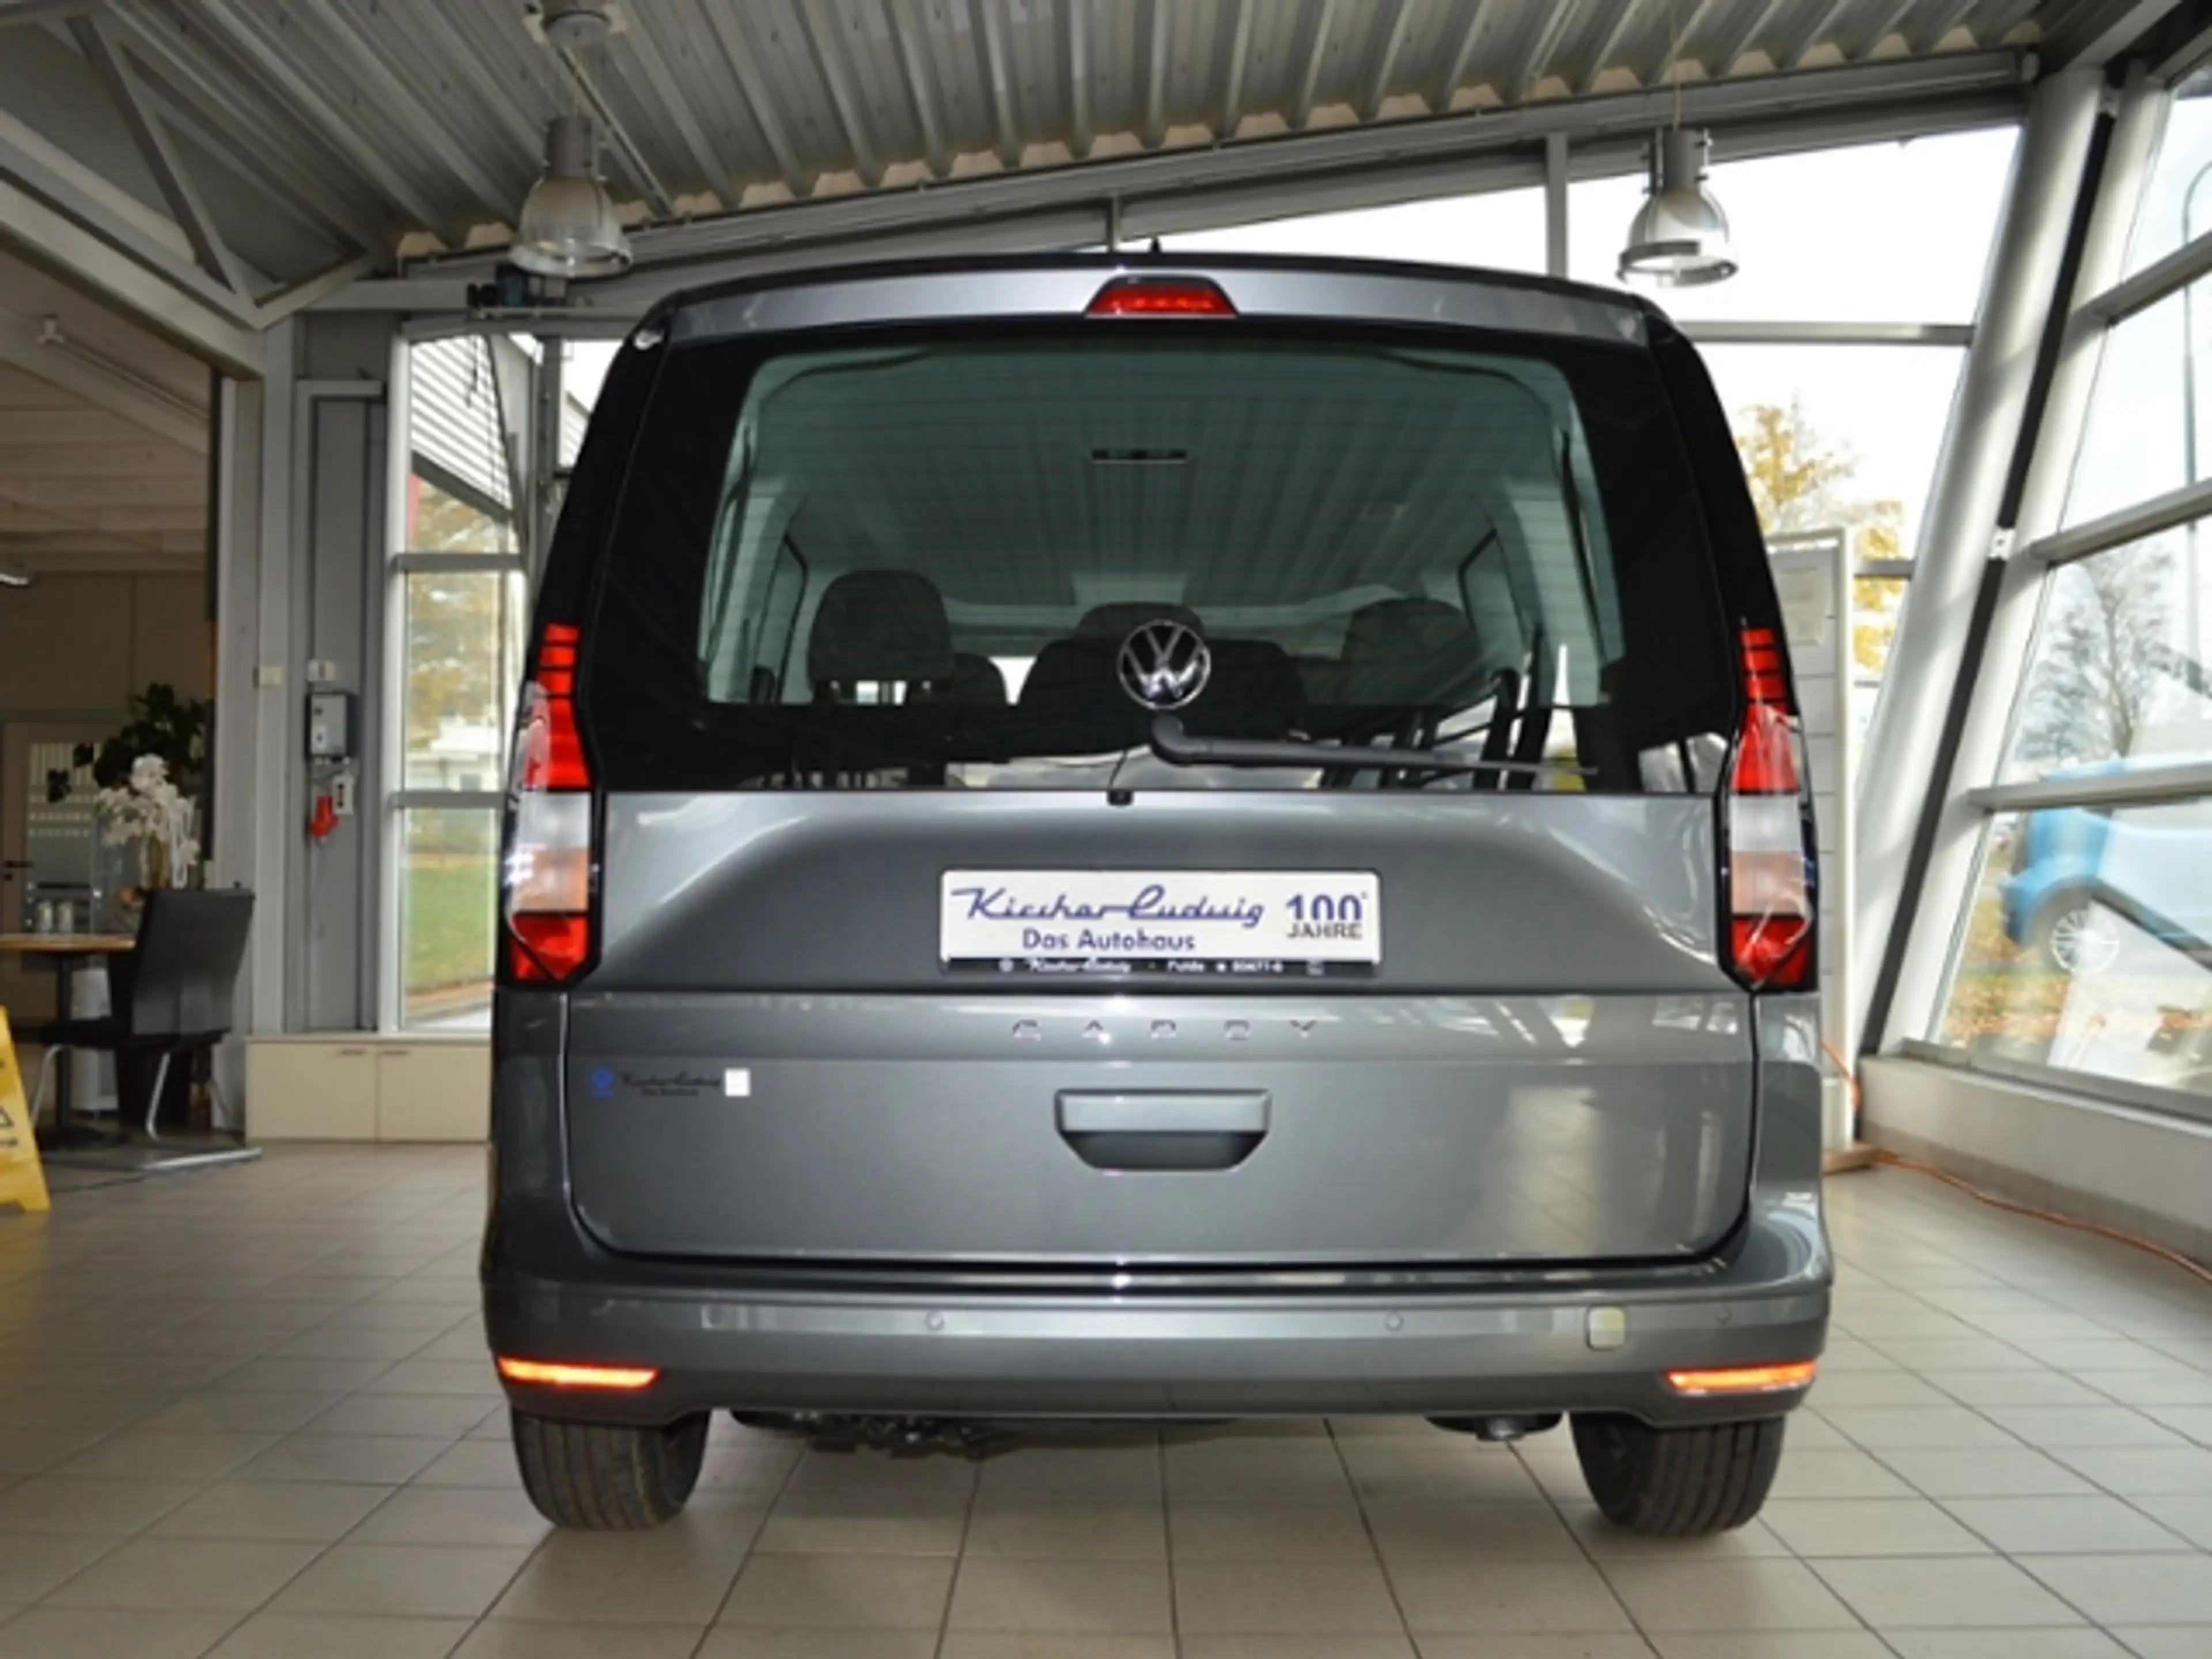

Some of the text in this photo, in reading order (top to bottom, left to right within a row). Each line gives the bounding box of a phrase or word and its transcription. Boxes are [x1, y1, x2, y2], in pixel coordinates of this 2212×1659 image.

[1285, 893, 1363, 921] 100
[1022, 928, 1196, 950] Das Autohaus
[1286, 923, 1363, 940] JAHRE
